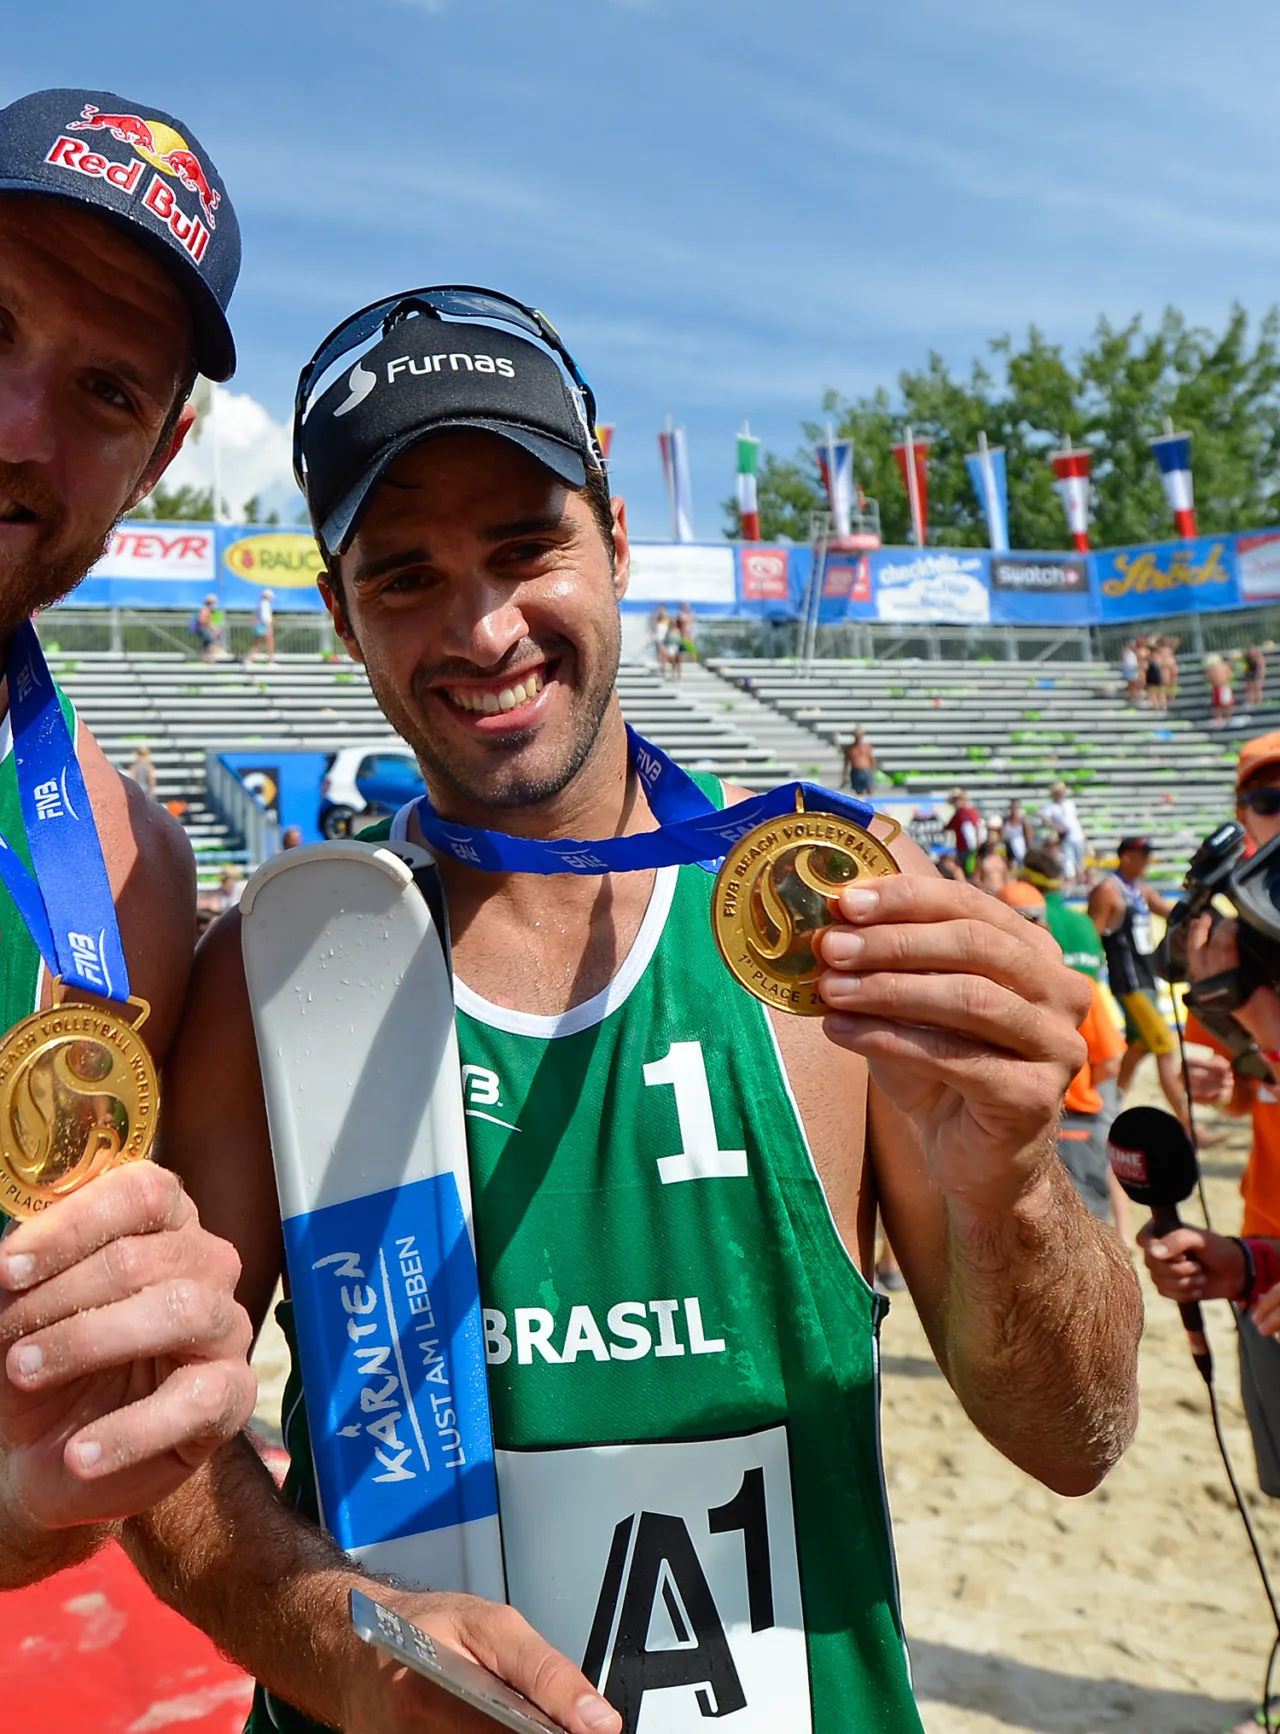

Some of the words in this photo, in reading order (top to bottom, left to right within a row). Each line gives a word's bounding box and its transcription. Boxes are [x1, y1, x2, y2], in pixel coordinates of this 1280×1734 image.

[44, 135, 146, 194] Red
[141, 174, 211, 265] Bull
[387, 353, 515, 384] Furnas
[113, 533, 208, 560] TEYR
[260, 549, 323, 570] RAUC
[636, 748, 663, 781] FIVB
[33, 779, 64, 821] FIVB
[724, 881, 741, 918] FIVB
[735, 831, 778, 878] BEACH
[782, 824, 880, 868] VOLLEYBALL
[67, 930, 103, 986] FIVB
[751, 971, 802, 1002] PLACE
[41, 1015, 132, 1054] VOLLEYBALL
[129, 1051, 151, 1117] WORLD
[643, 1040, 749, 1184] 1
[396, 1235, 436, 1332] LEBEN
[419, 1338, 449, 1385] AM
[483, 1297, 726, 1365] BRASIL
[430, 1392, 467, 1469] LUST
[580, 1465, 776, 1734] A1
